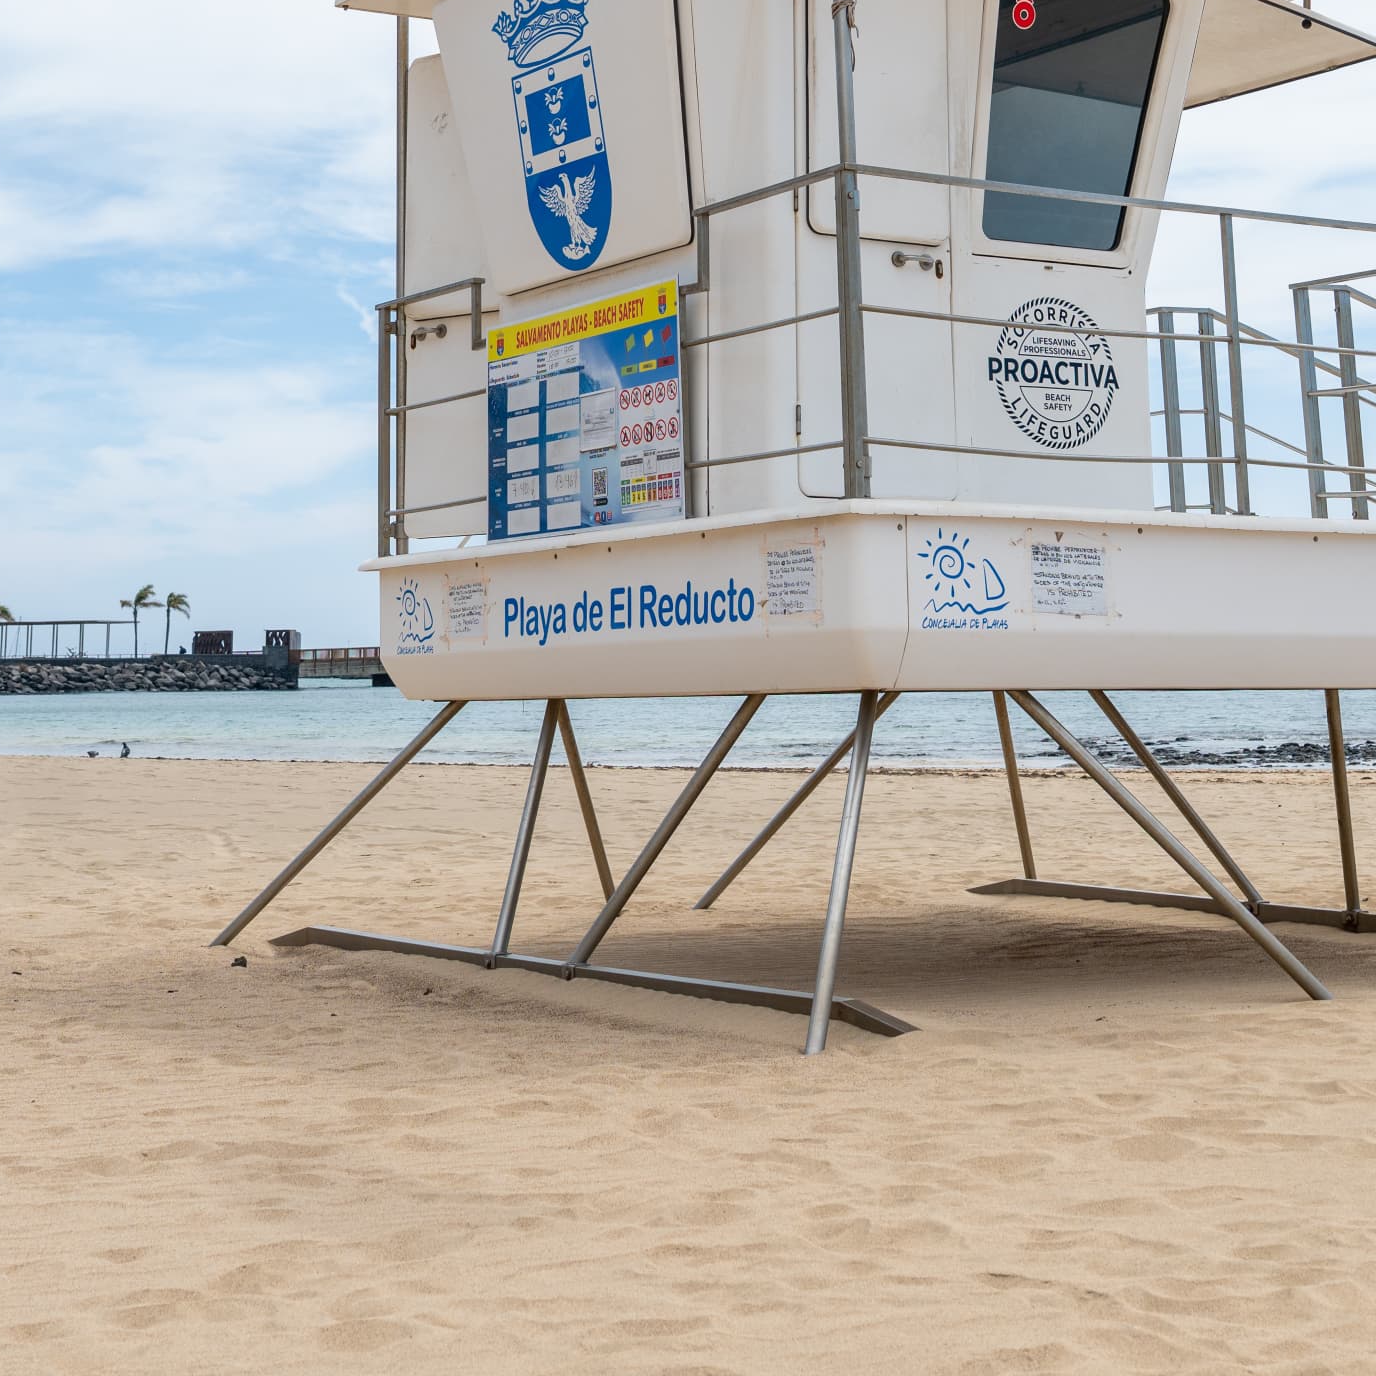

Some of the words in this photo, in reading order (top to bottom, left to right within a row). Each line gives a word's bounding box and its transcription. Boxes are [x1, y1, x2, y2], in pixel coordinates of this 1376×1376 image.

[516, 320, 561, 349] SALVAMENTO
[563, 313, 588, 336] PLAYAS
[593, 305, 617, 328] BEACH
[619, 297, 644, 322] SAFETY
[1032, 336, 1077, 347] LIFESAVING
[1024, 345, 1087, 357] PROFESSIONALS
[988, 356, 1120, 389] PROACTIVA
[1045, 393, 1072, 403] BEACH
[1043, 402, 1073, 412] SAFETY
[1011, 396, 1102, 440] LIFEGUARD
[504, 595, 567, 646] Playa
[573, 590, 603, 633] de
[610, 585, 632, 630] El
[639, 577, 755, 629] Reducto
[970, 618, 980, 629] DE
[982, 617, 1009, 630] PLAYAS
